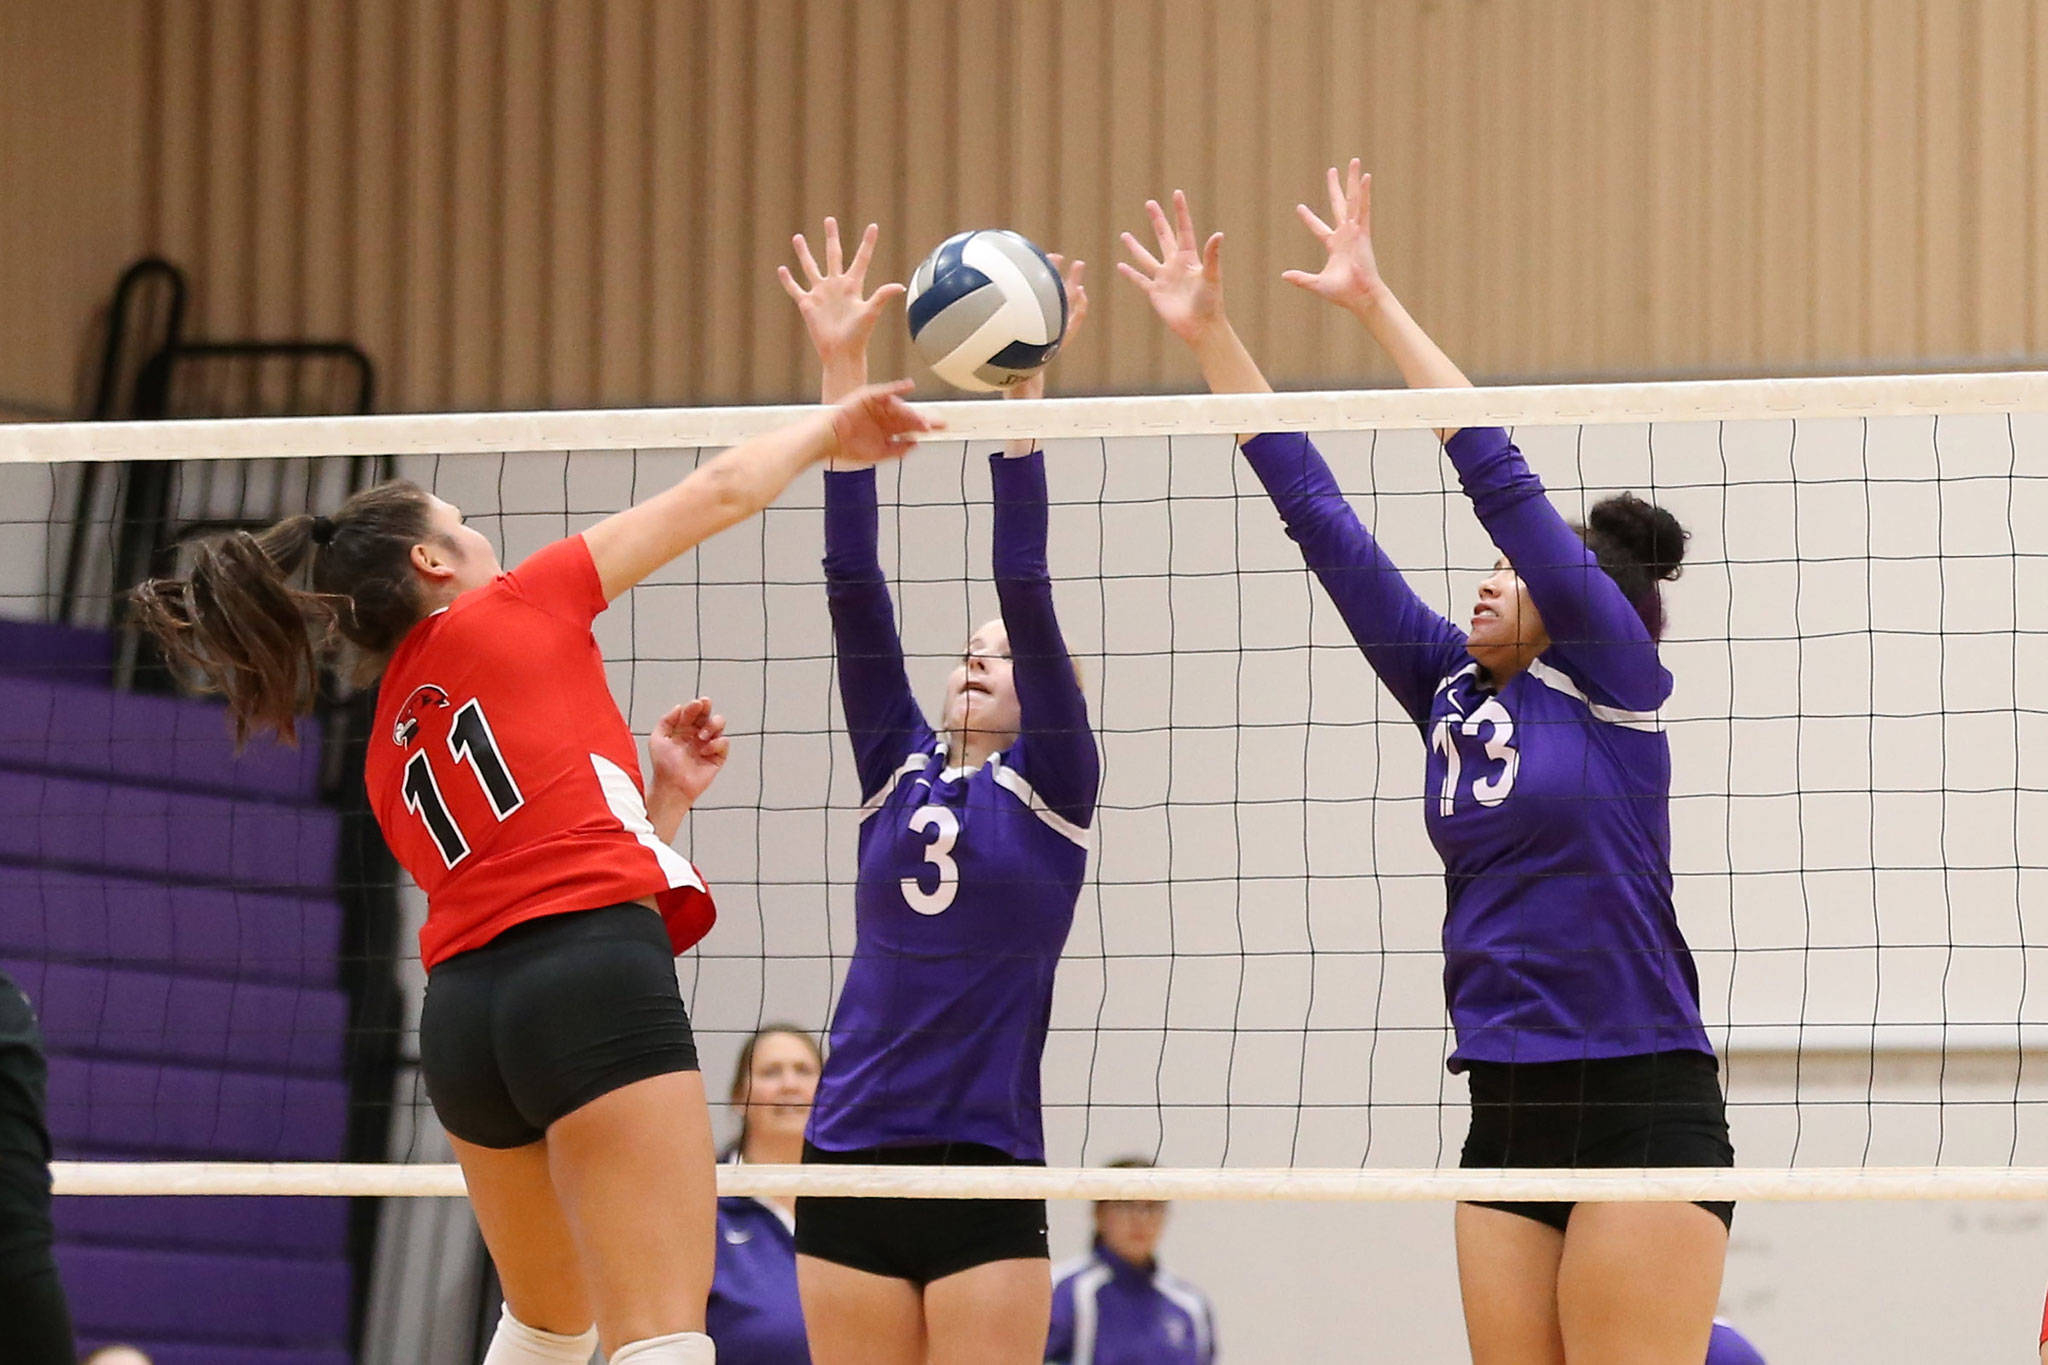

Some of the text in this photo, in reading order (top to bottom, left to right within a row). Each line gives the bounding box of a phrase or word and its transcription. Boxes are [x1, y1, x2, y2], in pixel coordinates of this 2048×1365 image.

[401, 697, 525, 870] 11
[1432, 695, 1520, 817] 13
[900, 804, 960, 916] 3
